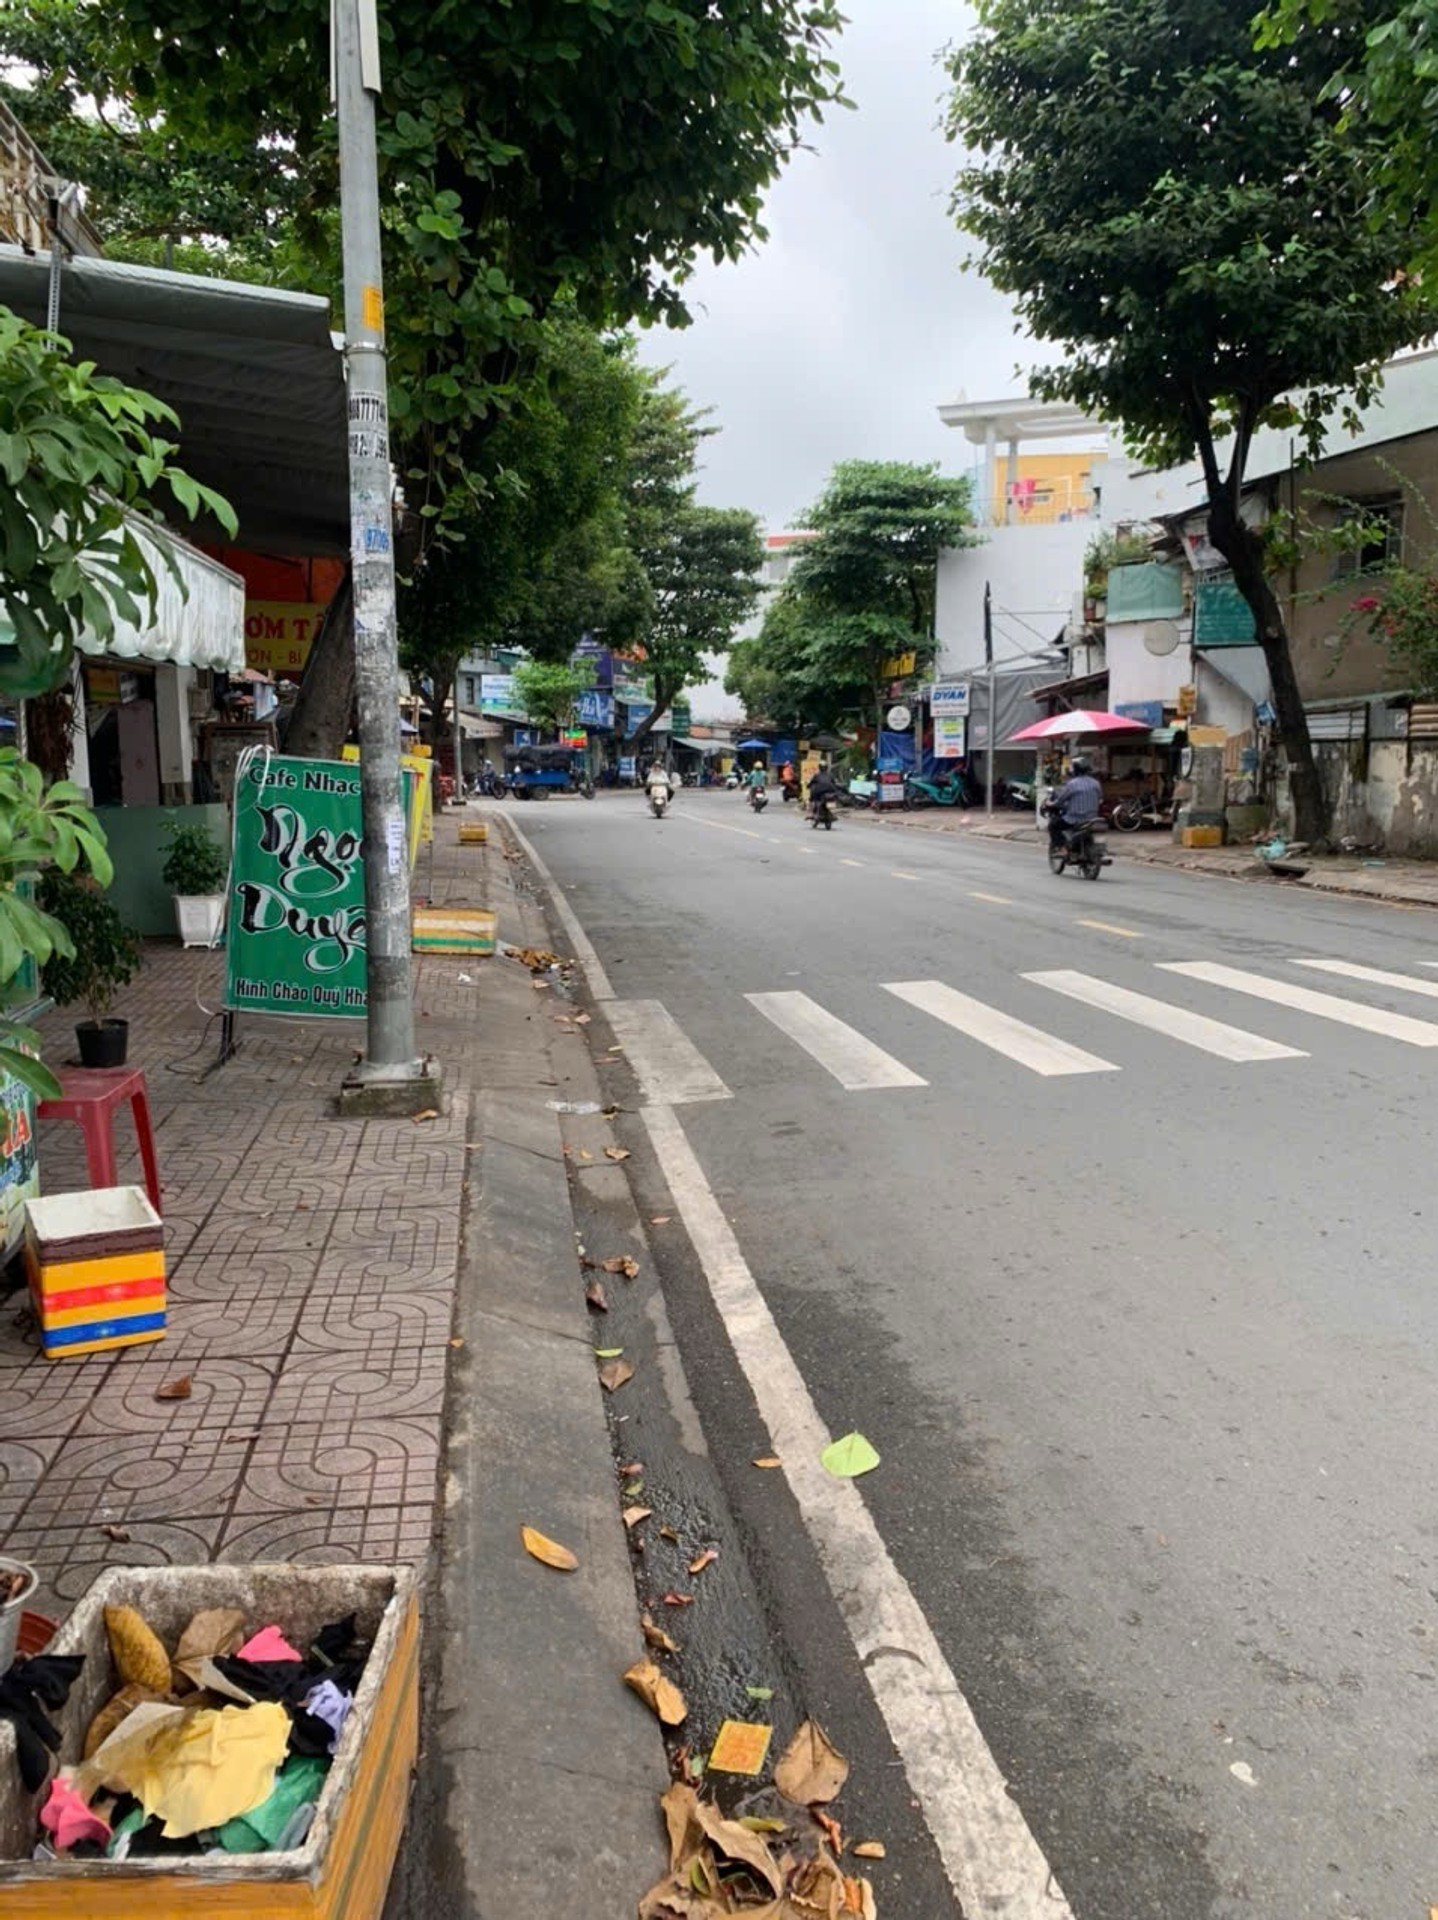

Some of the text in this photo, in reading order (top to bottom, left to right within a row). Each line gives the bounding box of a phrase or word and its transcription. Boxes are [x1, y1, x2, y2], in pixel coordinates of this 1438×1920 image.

[933, 690, 966, 701] DYAN
[247, 766, 362, 798] Cafe Nhạc
